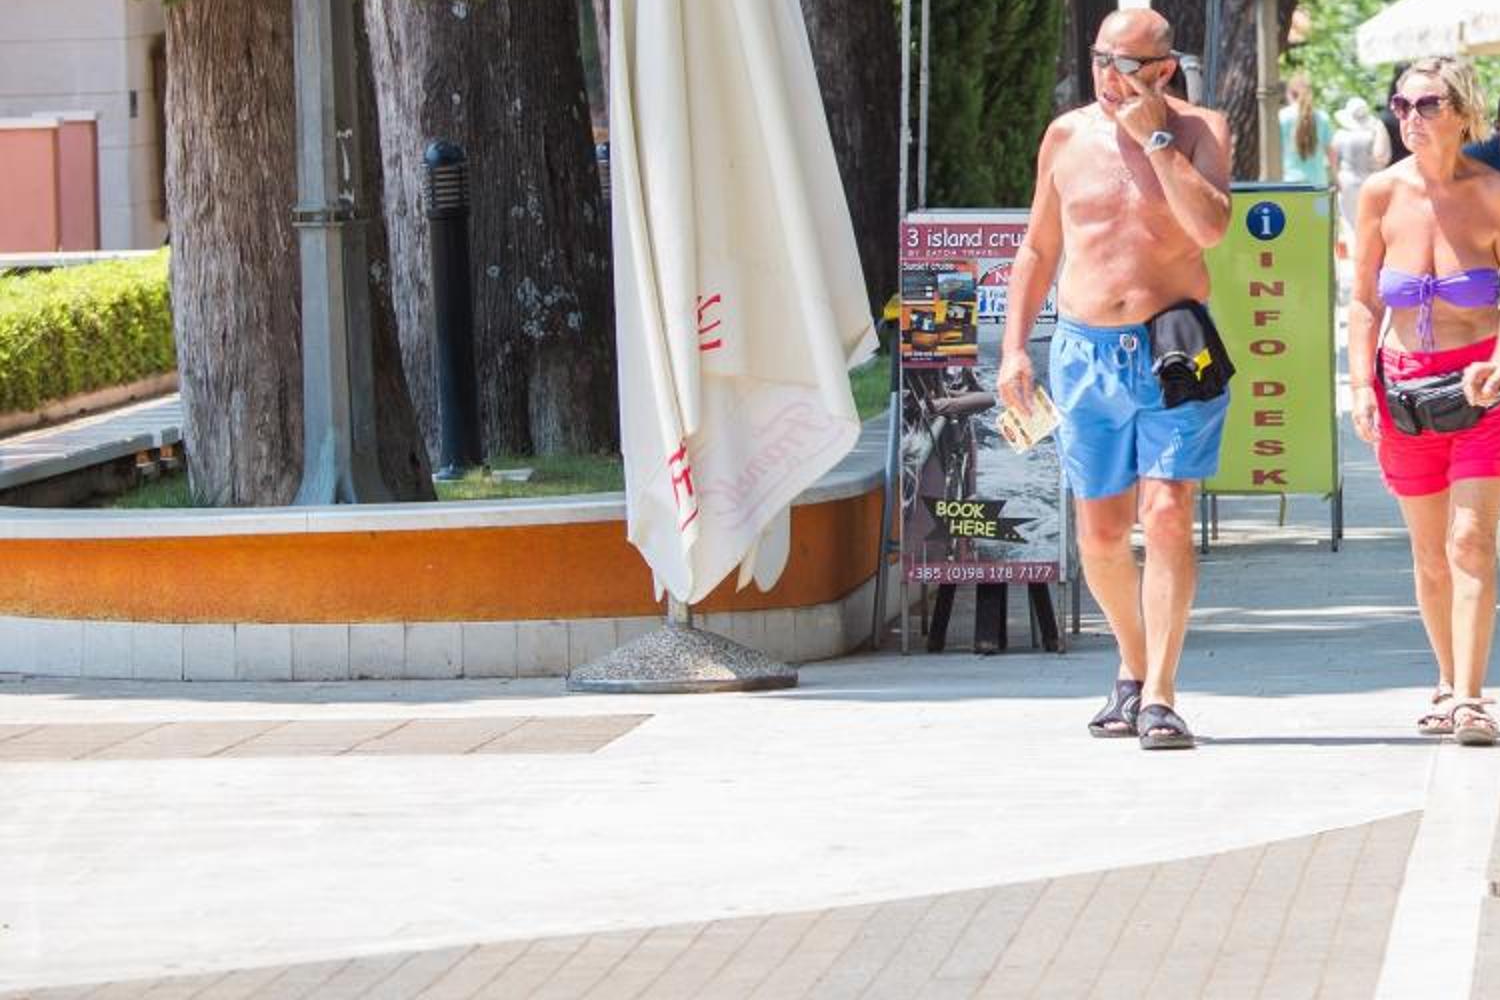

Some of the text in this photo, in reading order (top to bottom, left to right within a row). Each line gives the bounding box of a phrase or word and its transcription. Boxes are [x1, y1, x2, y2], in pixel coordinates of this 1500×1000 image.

[906, 228, 919, 247] 3
[927, 228, 982, 247] island
[1249, 250, 1286, 356] INFO
[1252, 381, 1288, 485] DESK
[935, 501, 985, 519] BOOK
[949, 519, 997, 537] HERE
[947, 567, 985, 582] (0)98
[990, 567, 1013, 580] 178
[1018, 566, 1052, 580] 7177
